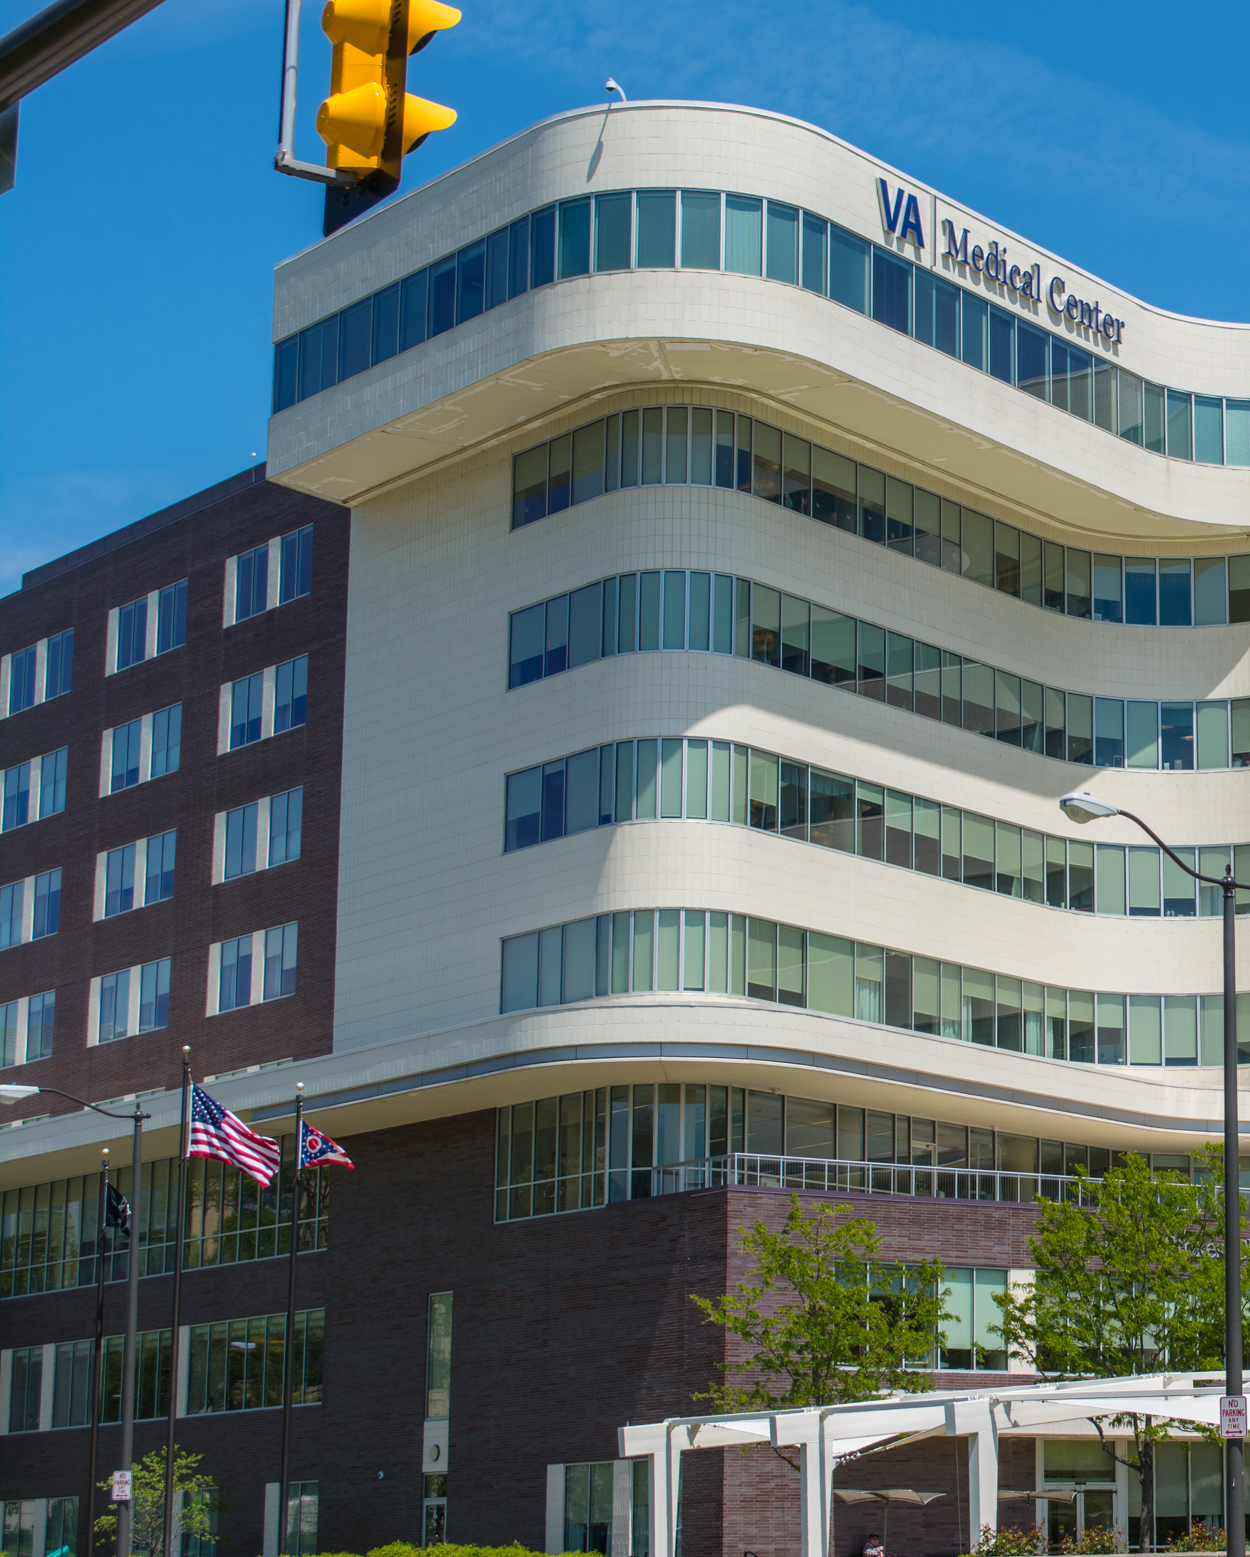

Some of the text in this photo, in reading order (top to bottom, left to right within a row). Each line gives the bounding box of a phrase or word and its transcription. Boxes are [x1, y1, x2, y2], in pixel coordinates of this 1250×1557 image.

[876, 177, 1125, 344] VA Medical Center
[1222, 1409, 1245, 1417] PARKING
